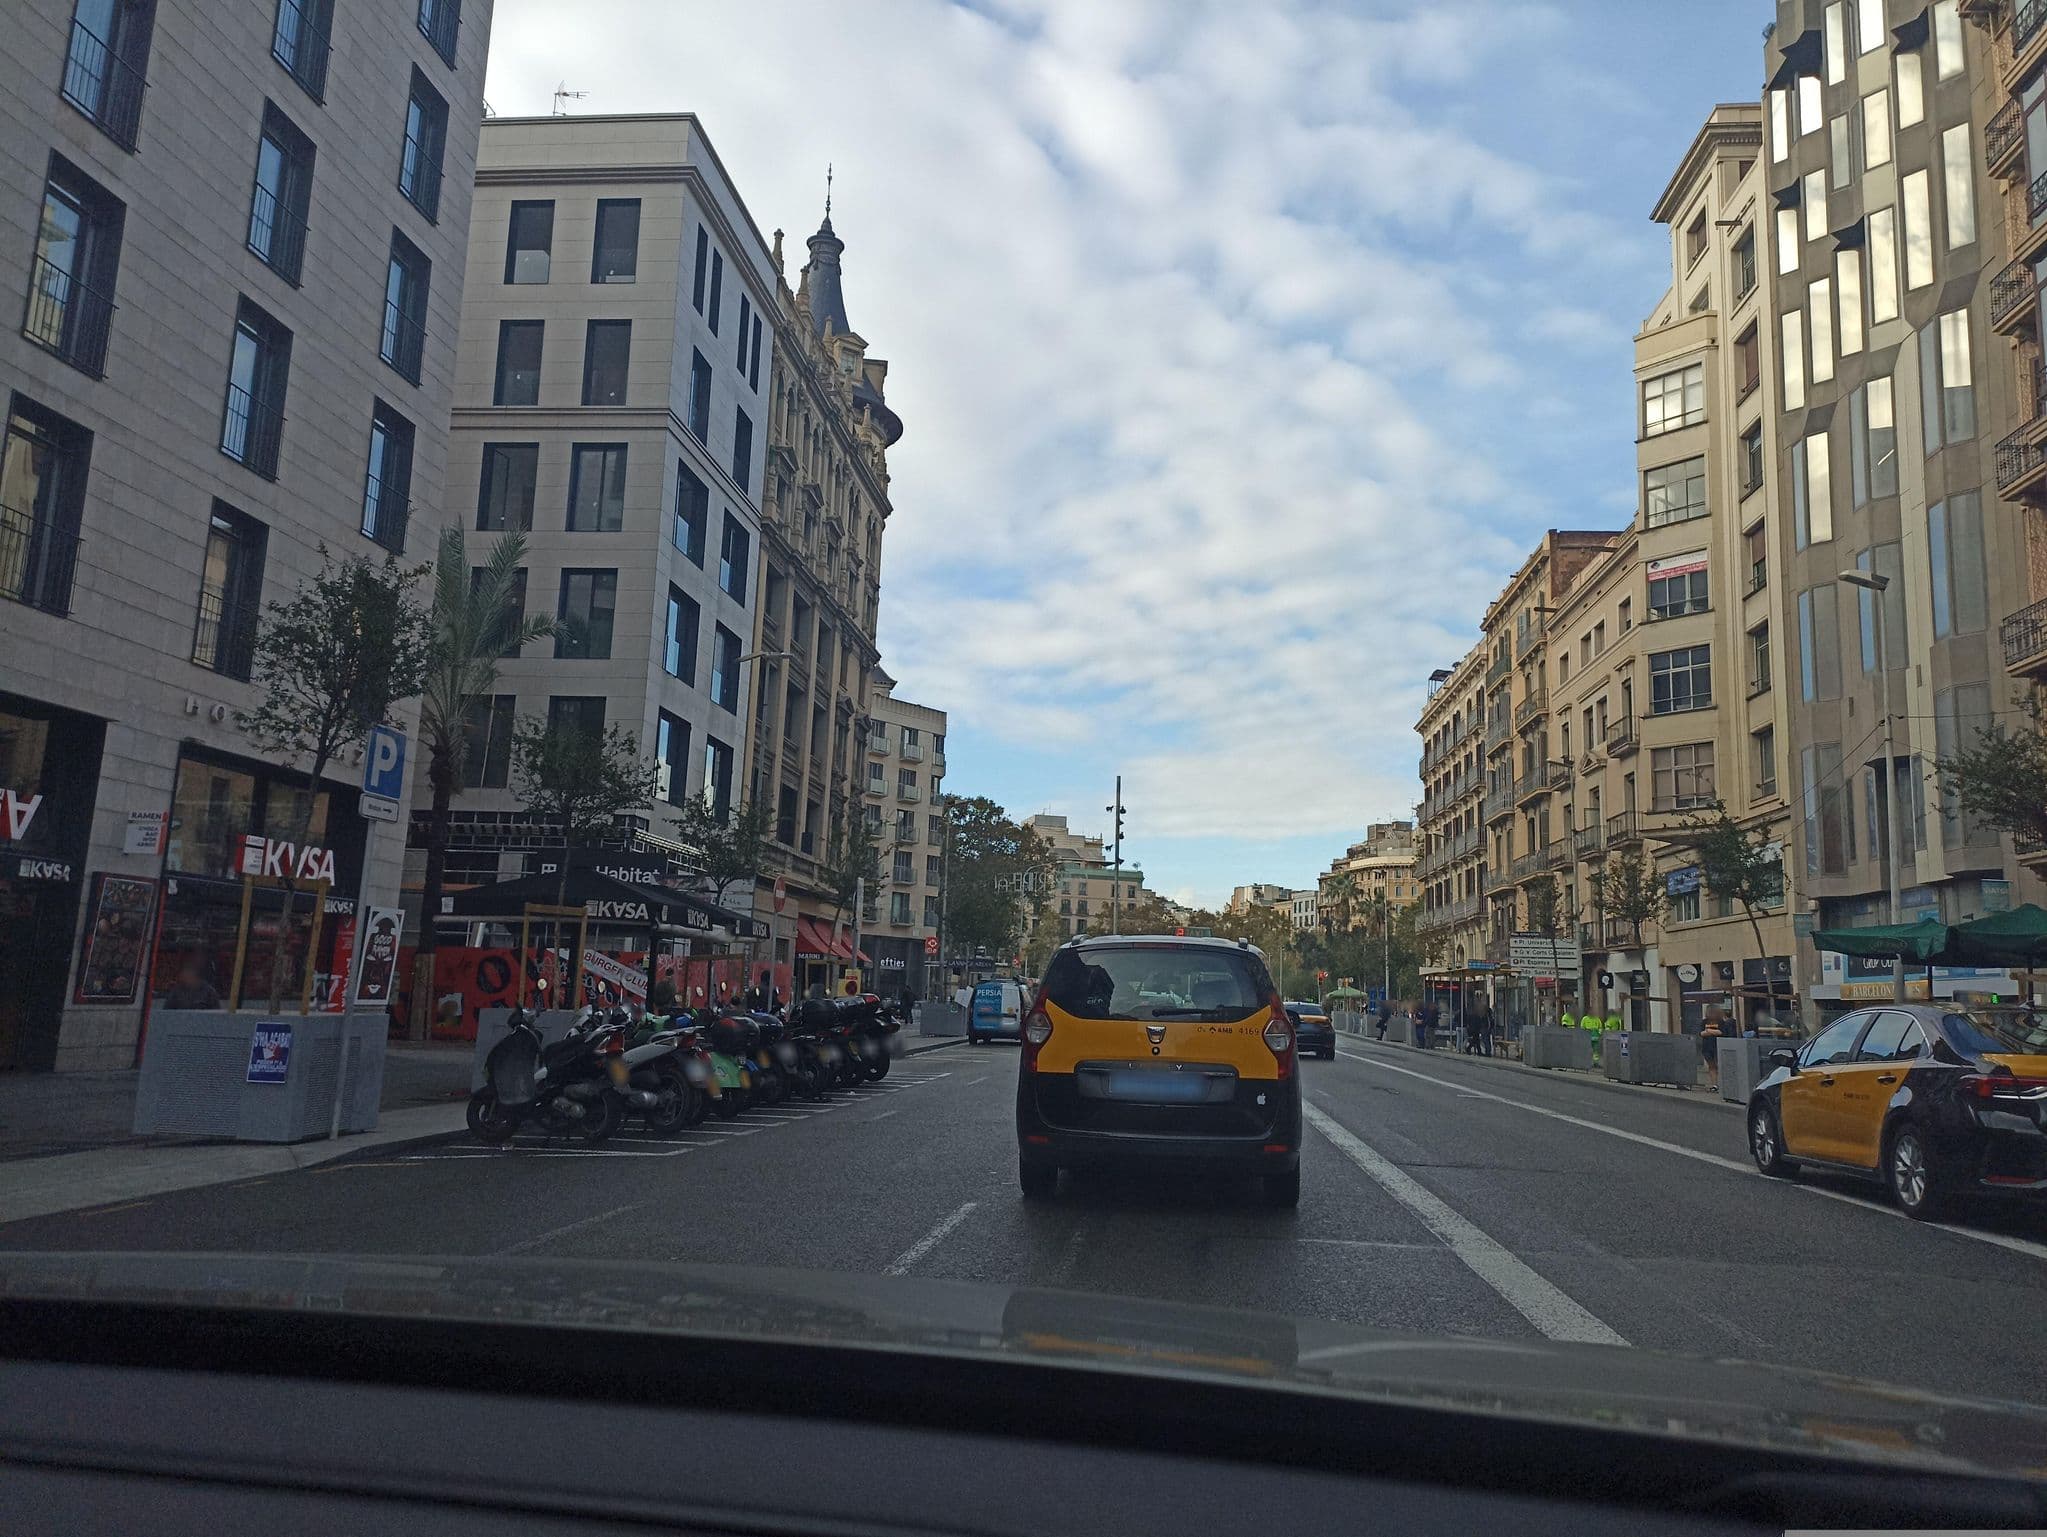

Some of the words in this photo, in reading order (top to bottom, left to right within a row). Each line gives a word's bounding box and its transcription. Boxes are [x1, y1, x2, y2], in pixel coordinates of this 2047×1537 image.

[371, 731, 398, 787] P
[131, 811, 162, 820] RAMEN
[595, 866, 660, 885] Habitat
